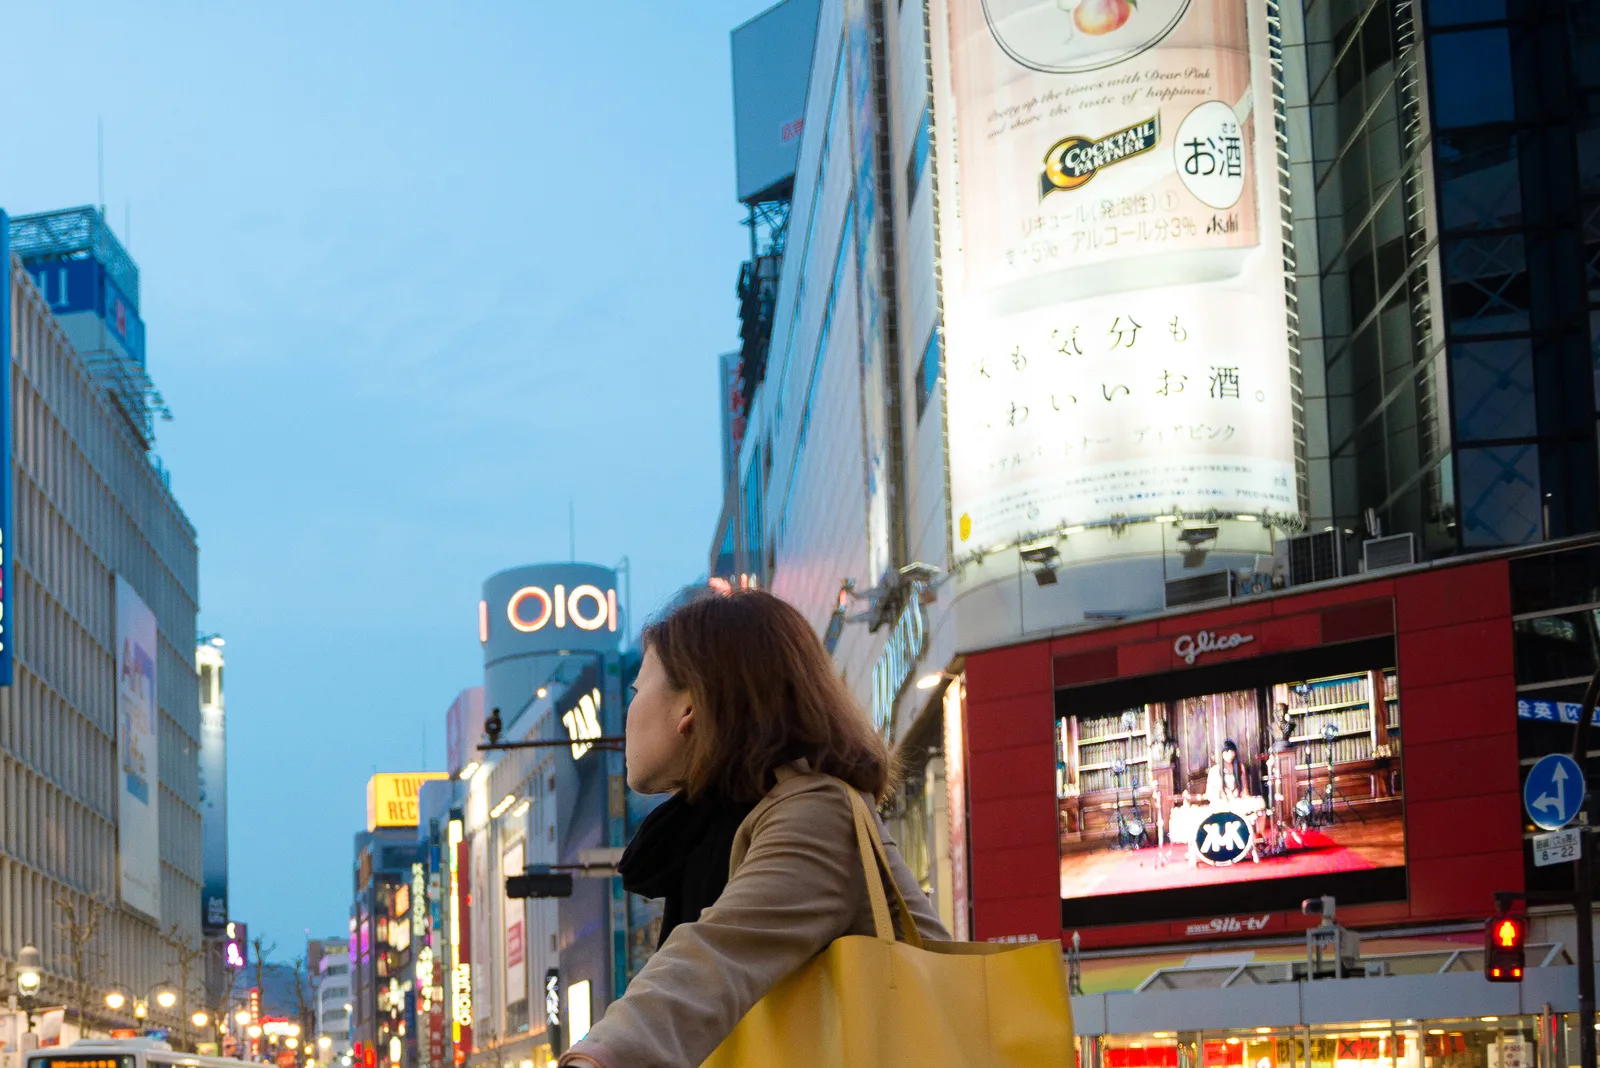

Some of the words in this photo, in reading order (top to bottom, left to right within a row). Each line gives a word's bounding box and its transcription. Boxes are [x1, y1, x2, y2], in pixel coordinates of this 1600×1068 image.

[1107, 71, 1141, 87] with
[1145, 69, 1181, 81] Dear
[1184, 67, 1211, 80] Pink
[1146, 84, 1212, 101] happiness!
[1063, 121, 1155, 170] COCKTAIL
[1073, 138, 1147, 178] PARTNER
[1183, 135, 1241, 178] お酒
[1206, 213, 1239, 235] Asahi
[1174, 630, 1254, 664] Glico
[546, 975, 560, 1026] ZARA
